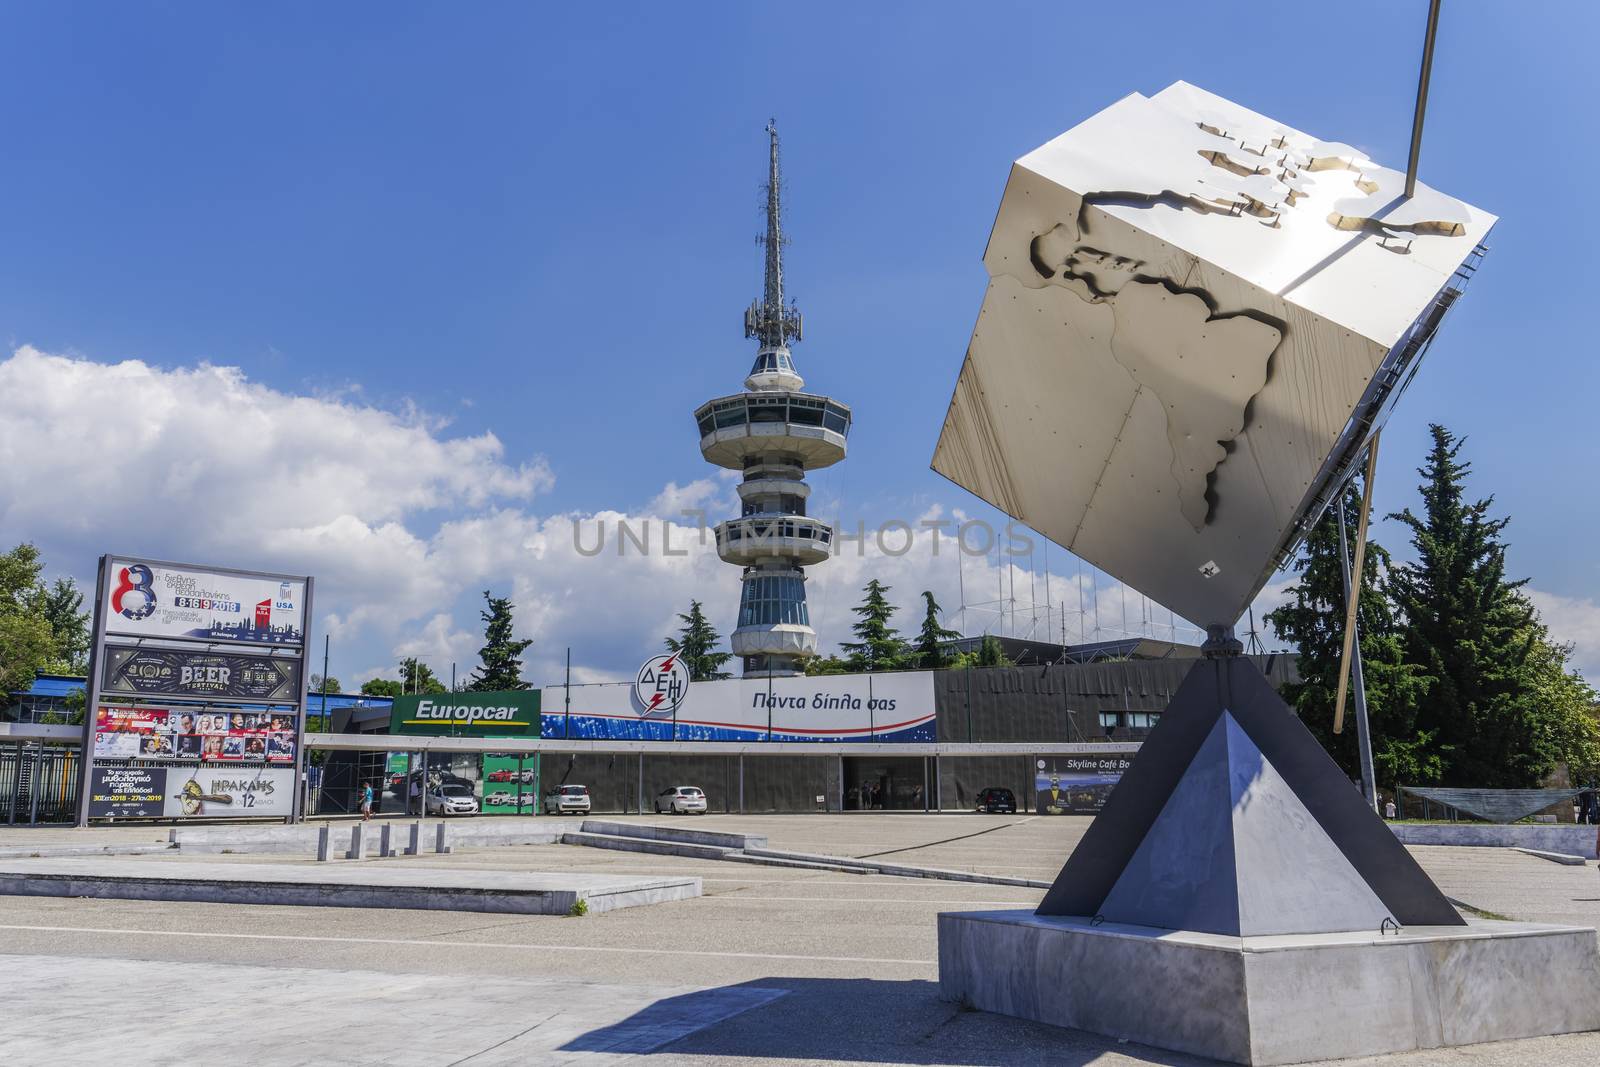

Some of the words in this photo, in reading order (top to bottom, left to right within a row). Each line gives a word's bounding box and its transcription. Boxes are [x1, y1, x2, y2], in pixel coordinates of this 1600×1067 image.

[213, 600, 237, 612] 2018
[276, 601, 294, 609] USA
[181, 666, 231, 685] BEER
[753, 692, 806, 709] Πάντα
[812, 692, 861, 710] δίπλα
[867, 697, 896, 711] σας
[416, 700, 519, 725] Europcar
[1067, 760, 1097, 770] Skyline
[1099, 759, 1117, 769] Café
[242, 793, 255, 808] 12
